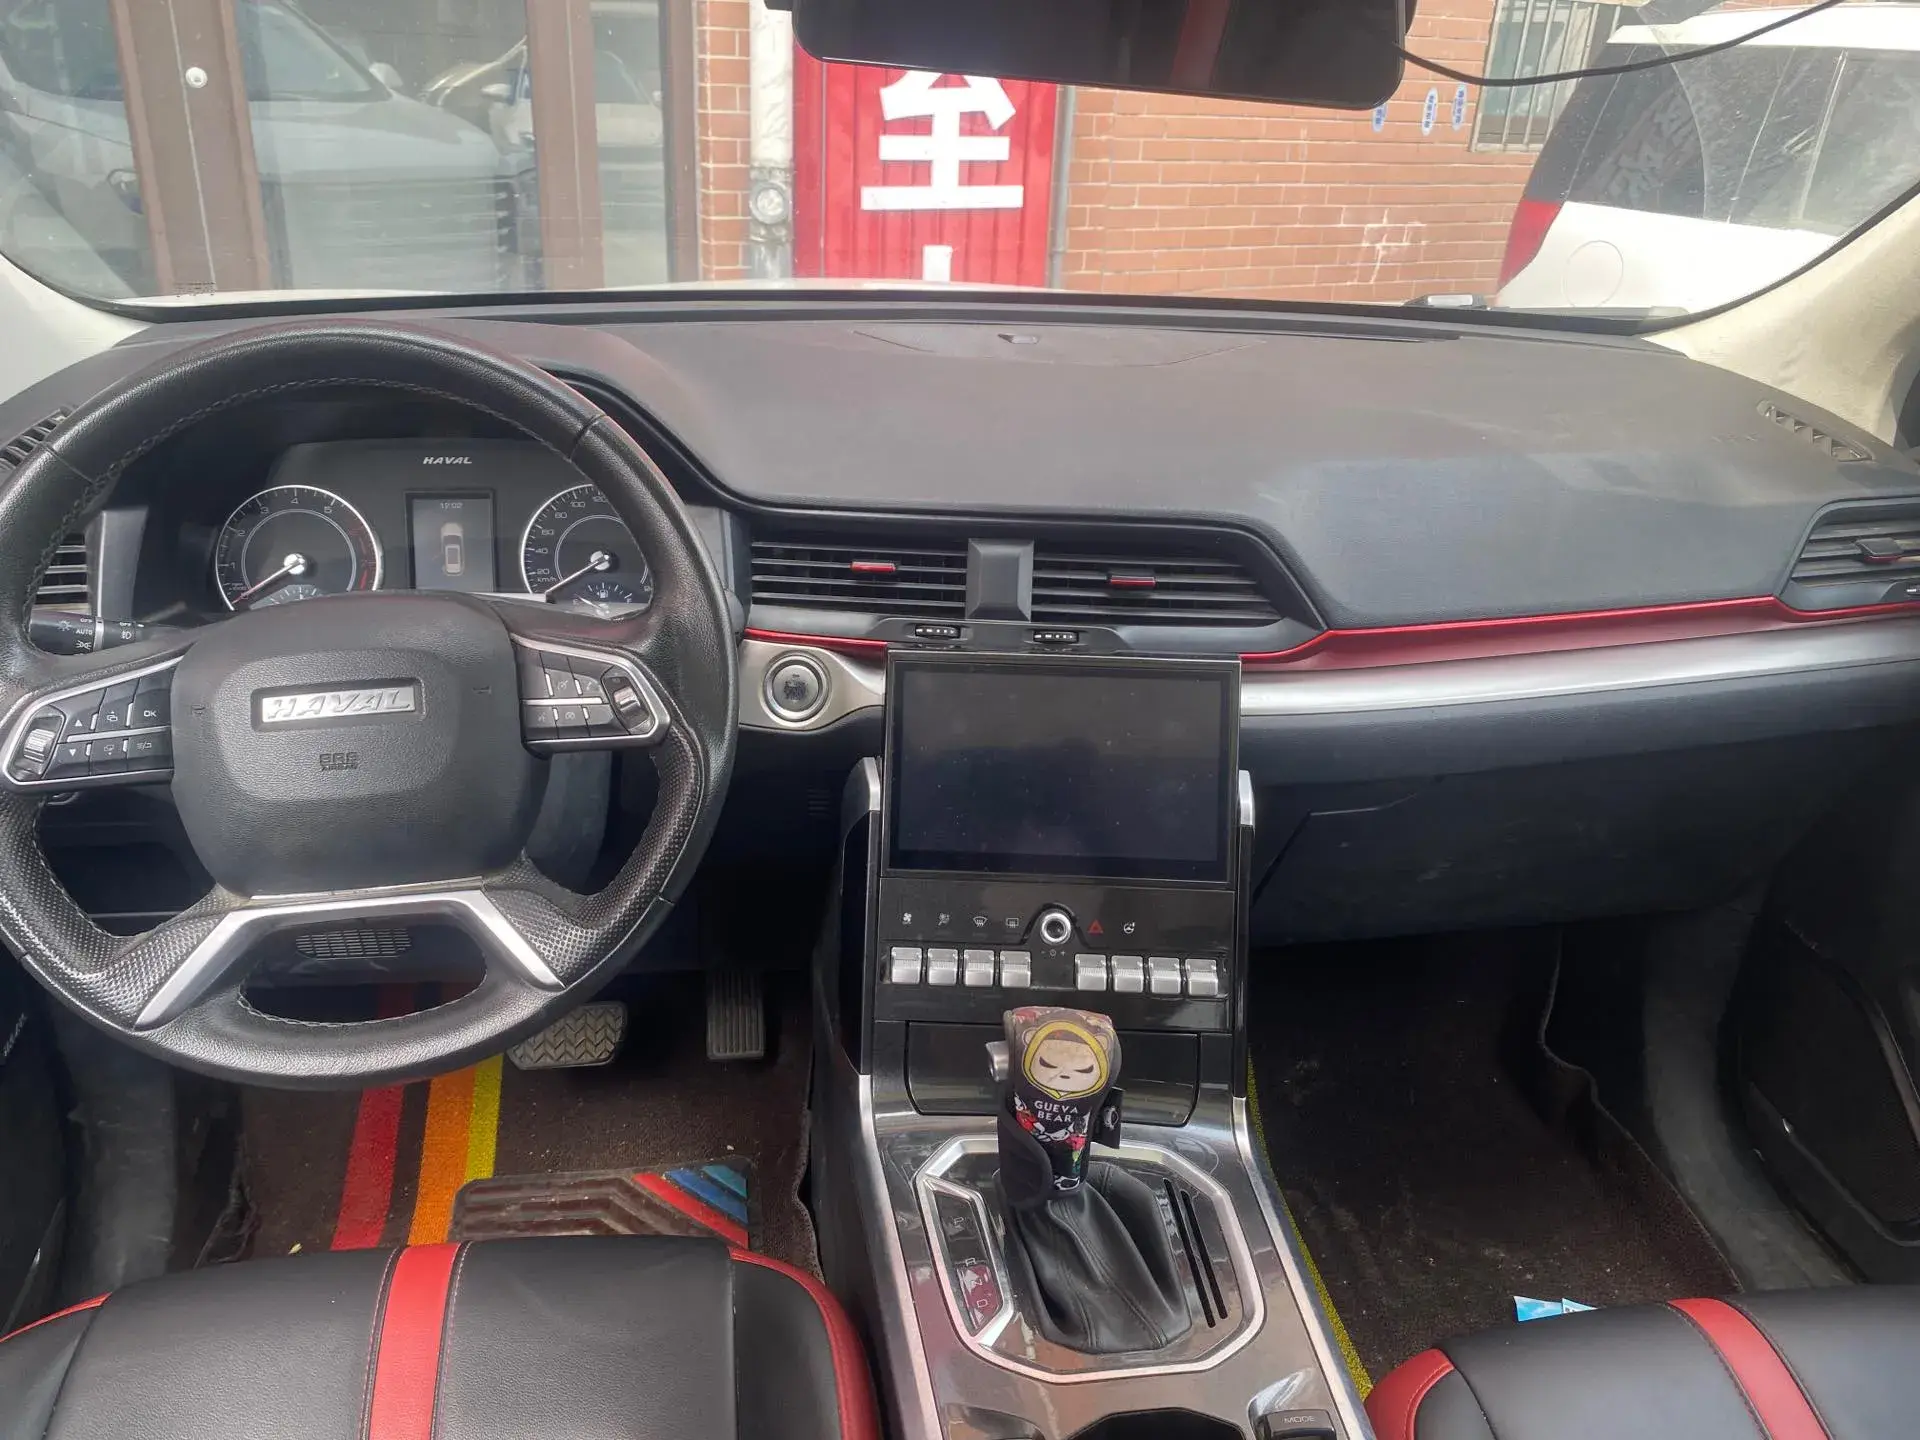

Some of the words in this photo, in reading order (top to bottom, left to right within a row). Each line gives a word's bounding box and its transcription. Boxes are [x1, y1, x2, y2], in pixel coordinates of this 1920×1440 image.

[423, 456, 473, 465] HAVAL
[260, 506, 269, 515] 3
[323, 506, 333, 514] 5
[266, 690, 412, 720] HAVAL
[1034, 1100, 1079, 1114] GUEVA
[1037, 1110, 1072, 1123] BEAR
